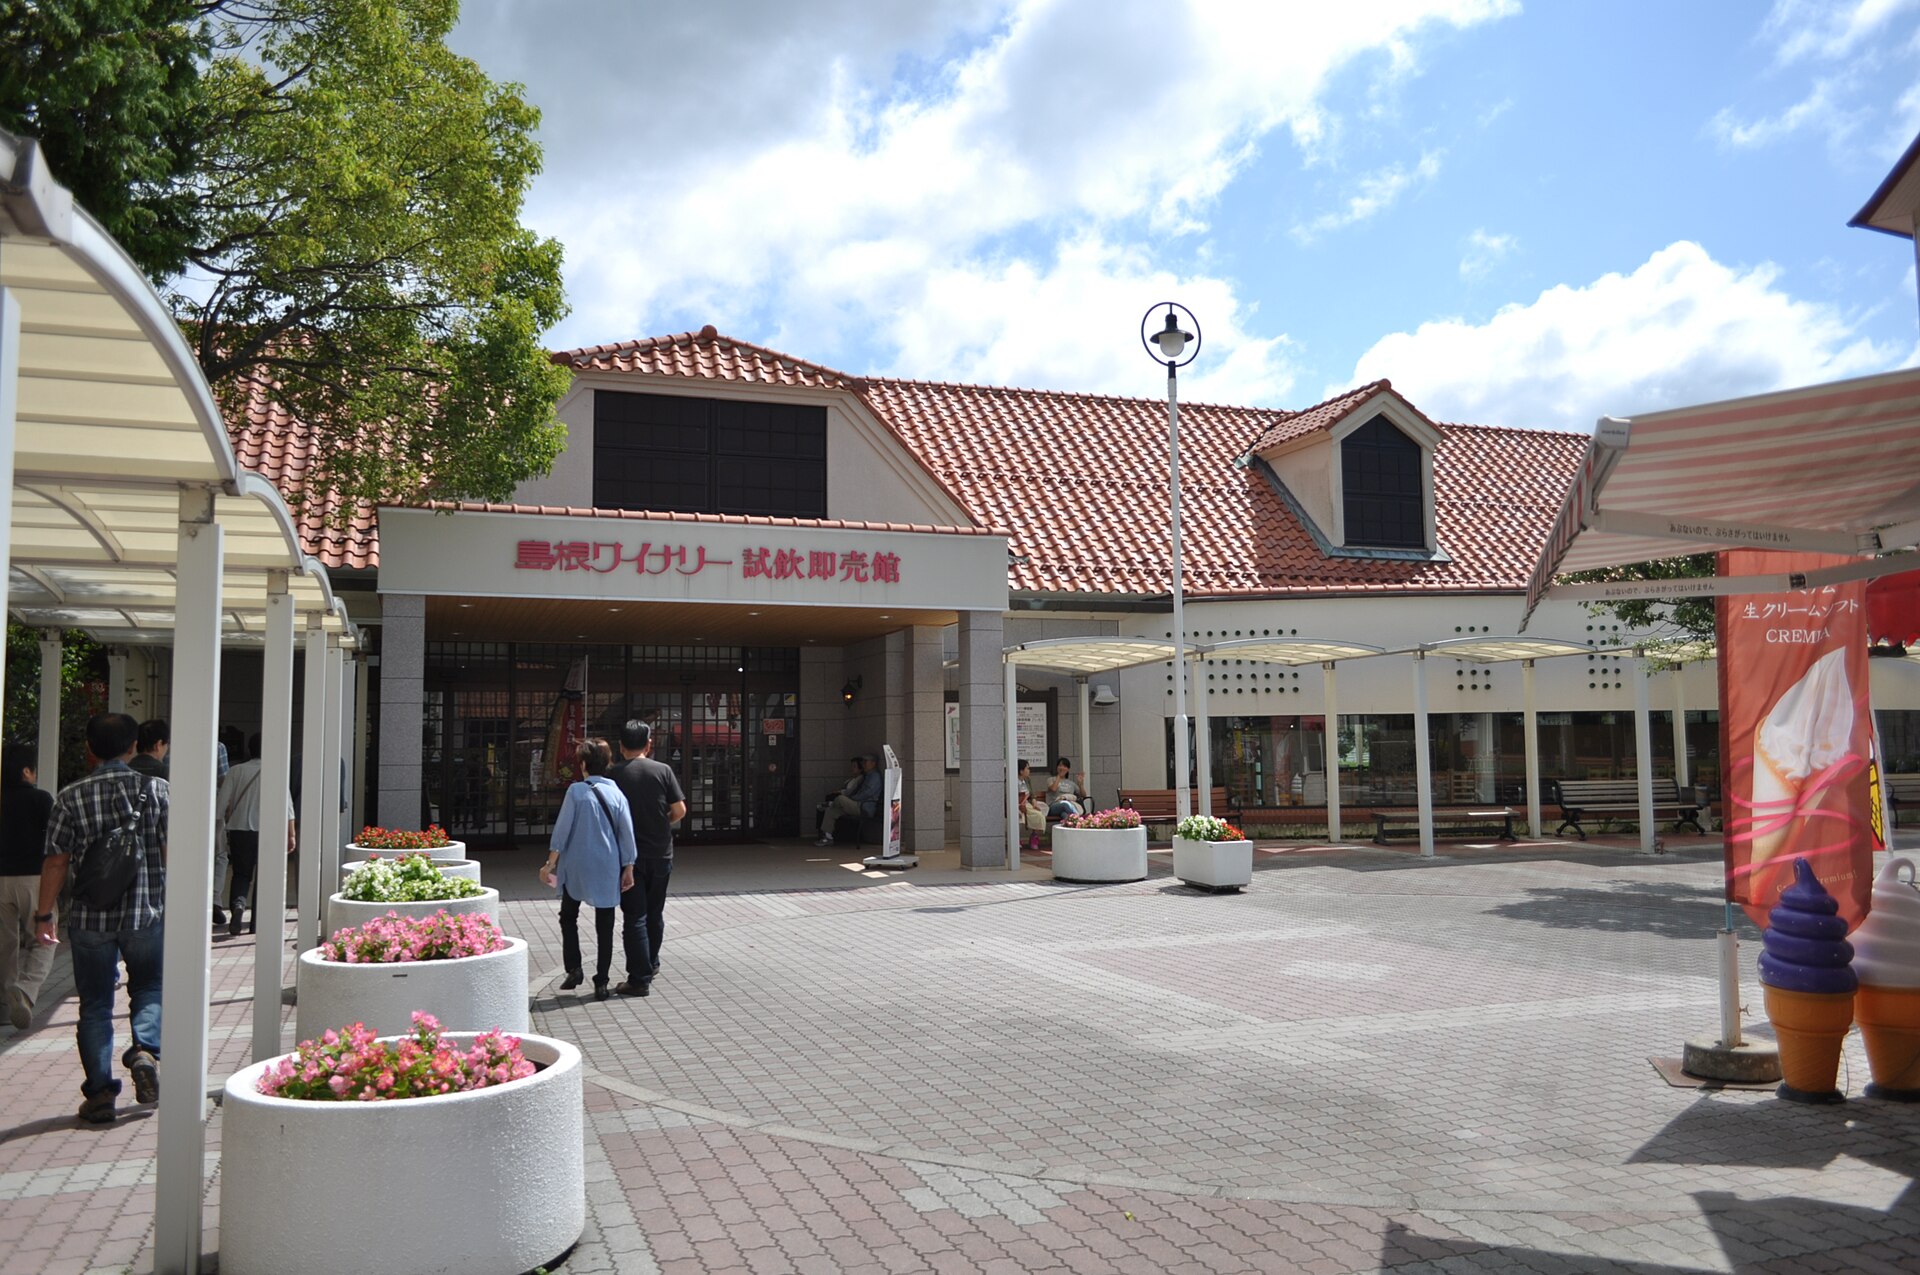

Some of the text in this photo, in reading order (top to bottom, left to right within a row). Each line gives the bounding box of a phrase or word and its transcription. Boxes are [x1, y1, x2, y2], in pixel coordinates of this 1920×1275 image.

[513, 539, 902, 584] 島根ワイナリー 試飲即売館
[1742, 598, 1860, 620] 生クリームソフト
[1765, 626, 1831, 644] CREMIA
